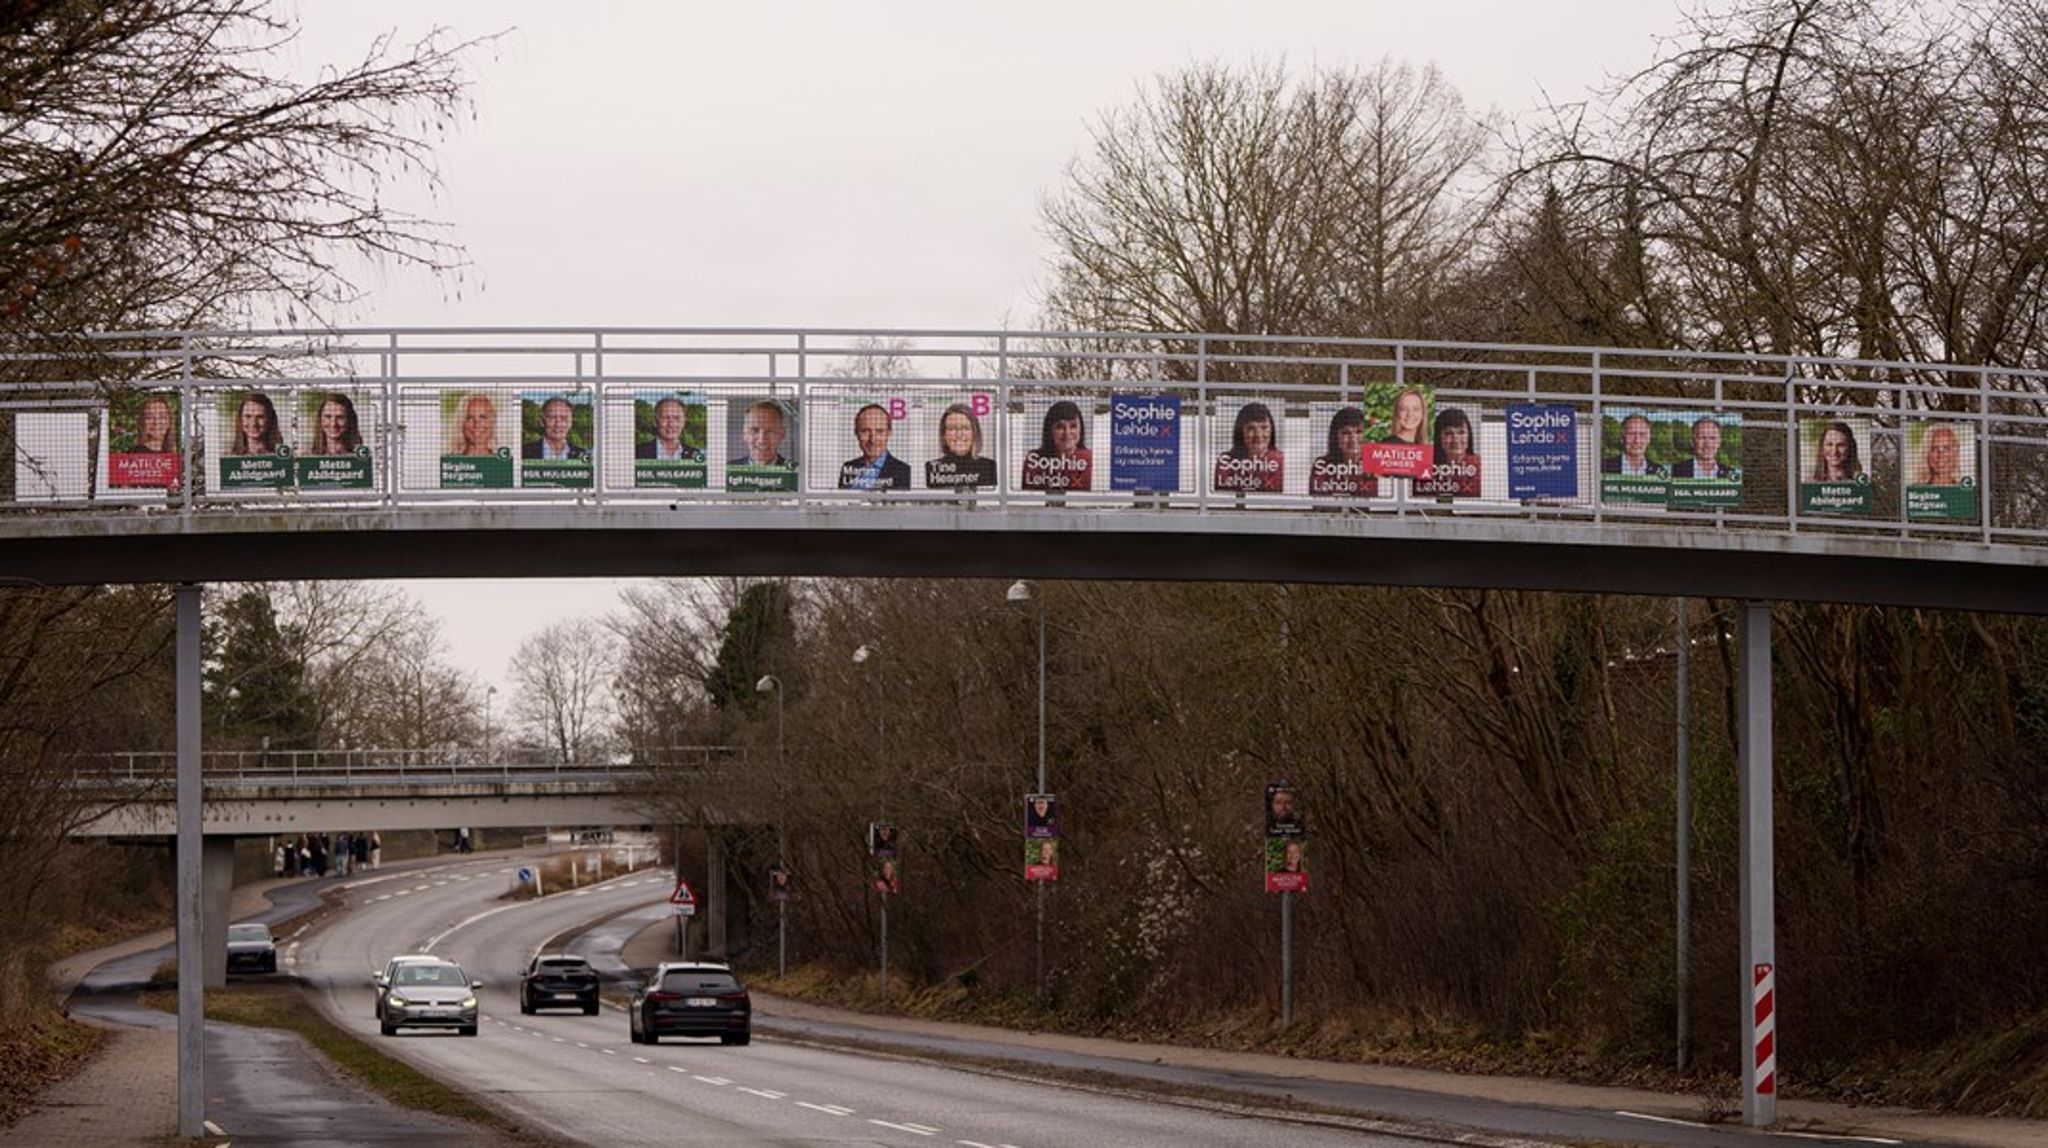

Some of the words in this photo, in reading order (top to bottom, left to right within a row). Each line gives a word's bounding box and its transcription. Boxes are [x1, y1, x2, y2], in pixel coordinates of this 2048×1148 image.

[889, 398, 906, 420] B
[972, 394, 990, 416] B
[1115, 402, 1176, 424] Sophie
[1510, 410, 1570, 432] Sophie
[501, 448, 508, 458] C
[1372, 450, 1424, 461] MATILDE
[118, 458, 171, 470] MATILDE
[240, 460, 273, 470] Mette
[319, 460, 352, 470] Mette
[931, 462, 956, 472] Tine
[1027, 452, 1087, 475] Sophie
[1218, 454, 1279, 476] Sophie
[1314, 457, 1363, 479] Sophi
[1432, 460, 1477, 480] ophie
[1963, 477, 1971, 487] C
[1821, 486, 1852, 496] Mette
